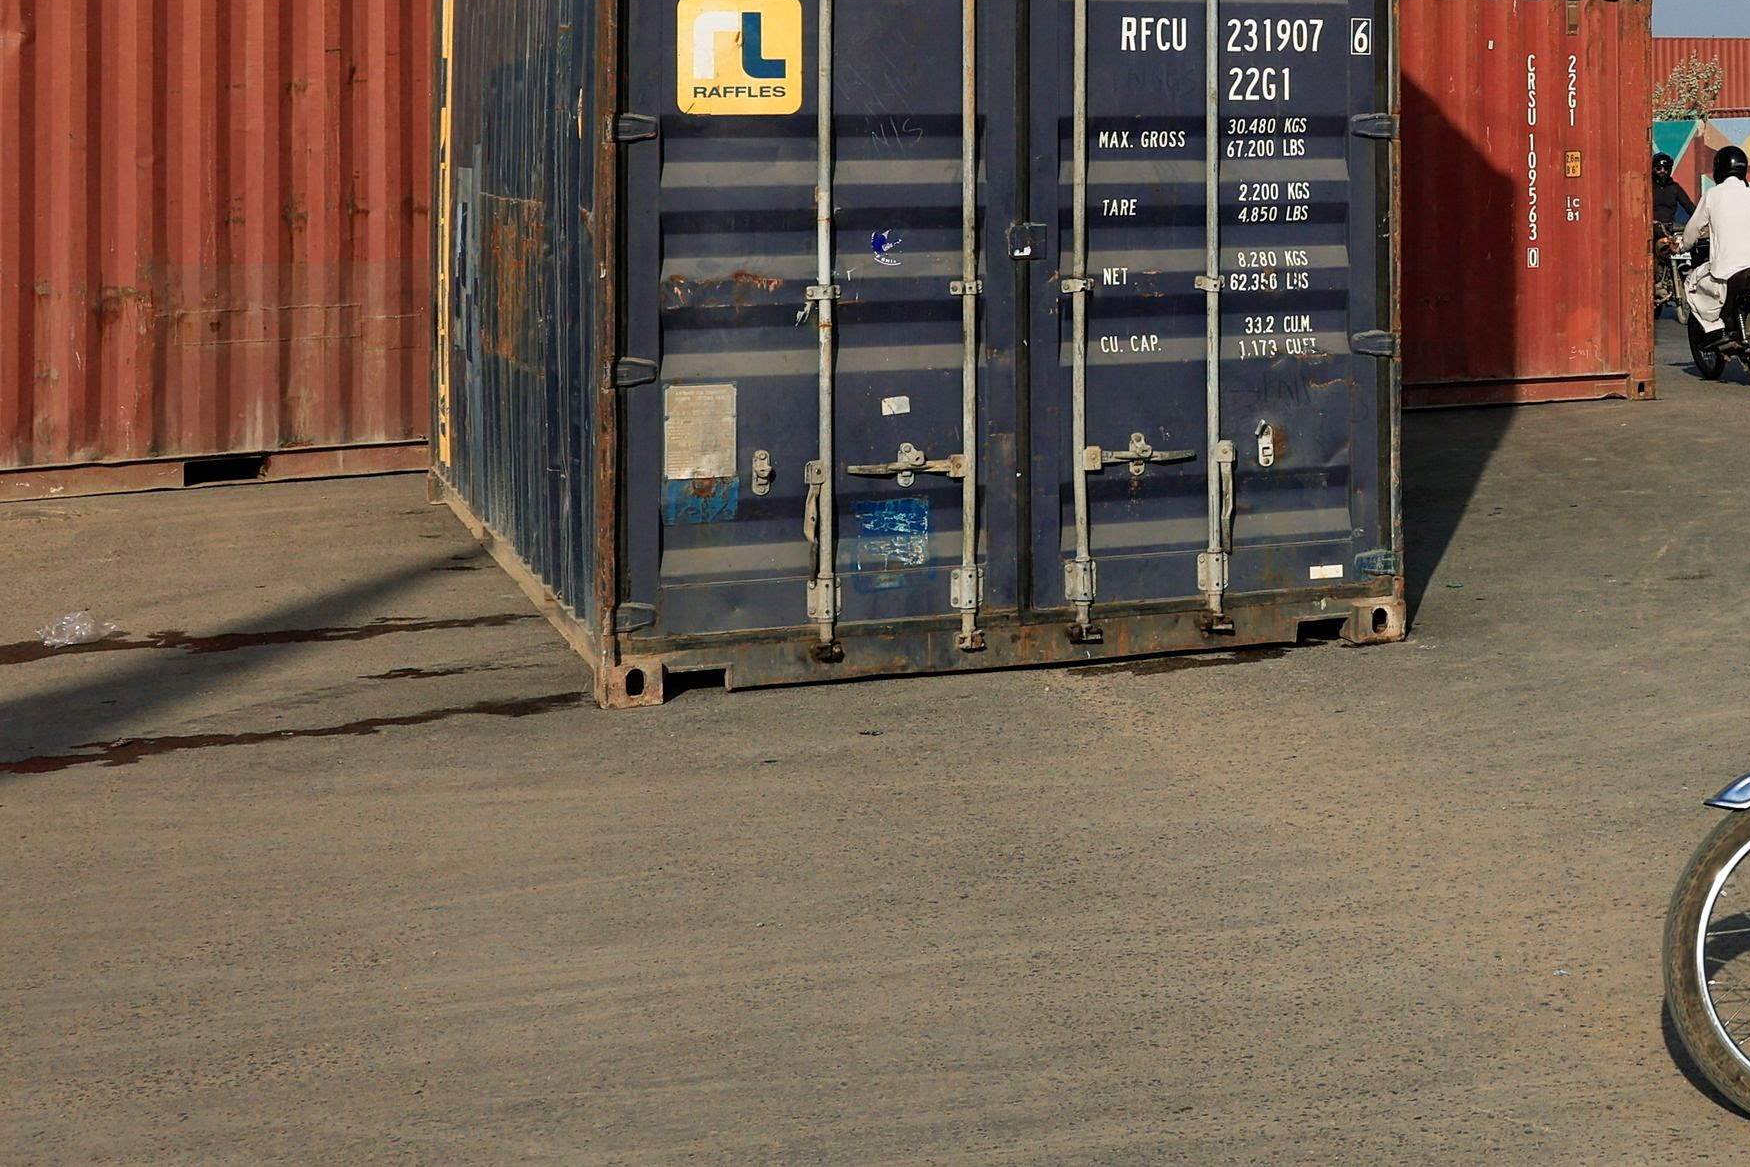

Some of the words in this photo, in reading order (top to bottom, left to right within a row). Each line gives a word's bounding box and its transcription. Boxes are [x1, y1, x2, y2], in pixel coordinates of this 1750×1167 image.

[1121, 16, 1188, 52] RFCU
[1226, 18, 1325, 53] 231907
[1353, 21, 1369, 53] 6
[693, 85, 787, 99] RAFFLES
[1227, 66, 1292, 101] 22G1
[1526, 54, 1537, 126] CRSU
[1567, 54, 1578, 127] 22G1
[1099, 131, 1135, 149] MAX.
[1140, 130, 1187, 149] GROSS
[1283, 117, 1308, 134] KGS
[1282, 138, 1306, 157] LBS
[1102, 198, 1138, 217] TARE
[1287, 182, 1311, 200] KGS
[1528, 132, 1538, 242] 109563
[1285, 205, 1310, 222] LBS
[1566, 210, 1580, 222] 81
[1103, 267, 1128, 286] NET
[1284, 250, 1309, 267] KGS
[1100, 336, 1122, 354] CU.
[1130, 334, 1163, 353] CAP.
[1244, 315, 1275, 334] 33.2
